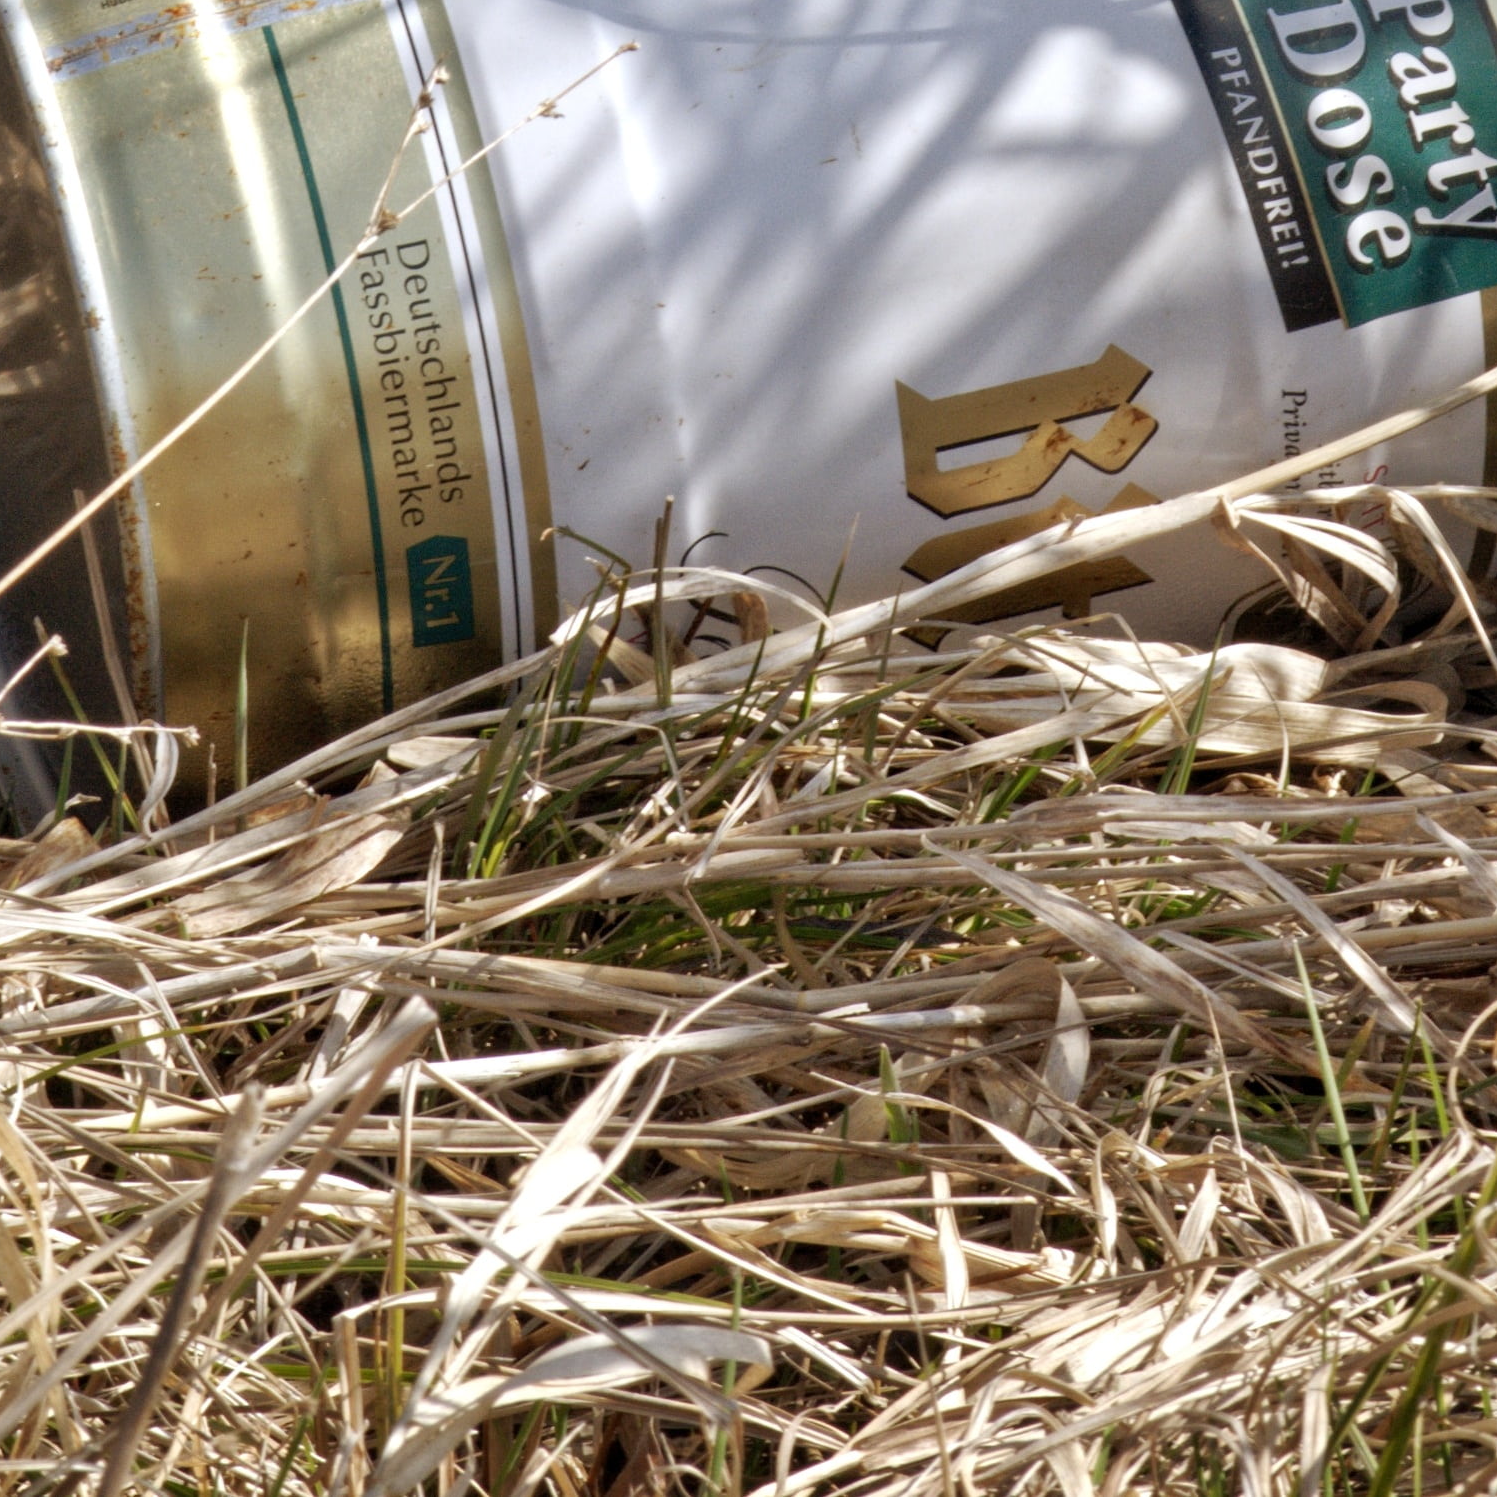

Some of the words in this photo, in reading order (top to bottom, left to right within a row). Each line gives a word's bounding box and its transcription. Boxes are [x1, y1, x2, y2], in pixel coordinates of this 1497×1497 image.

[1210, 46, 1310, 269] PFANDFREI!
[357, 247, 432, 529] Fassbiermarke
[396, 238, 471, 504] Deutschlands
[422, 553, 462, 629] Nr.1
[1359, 464, 1389, 531] SIT
